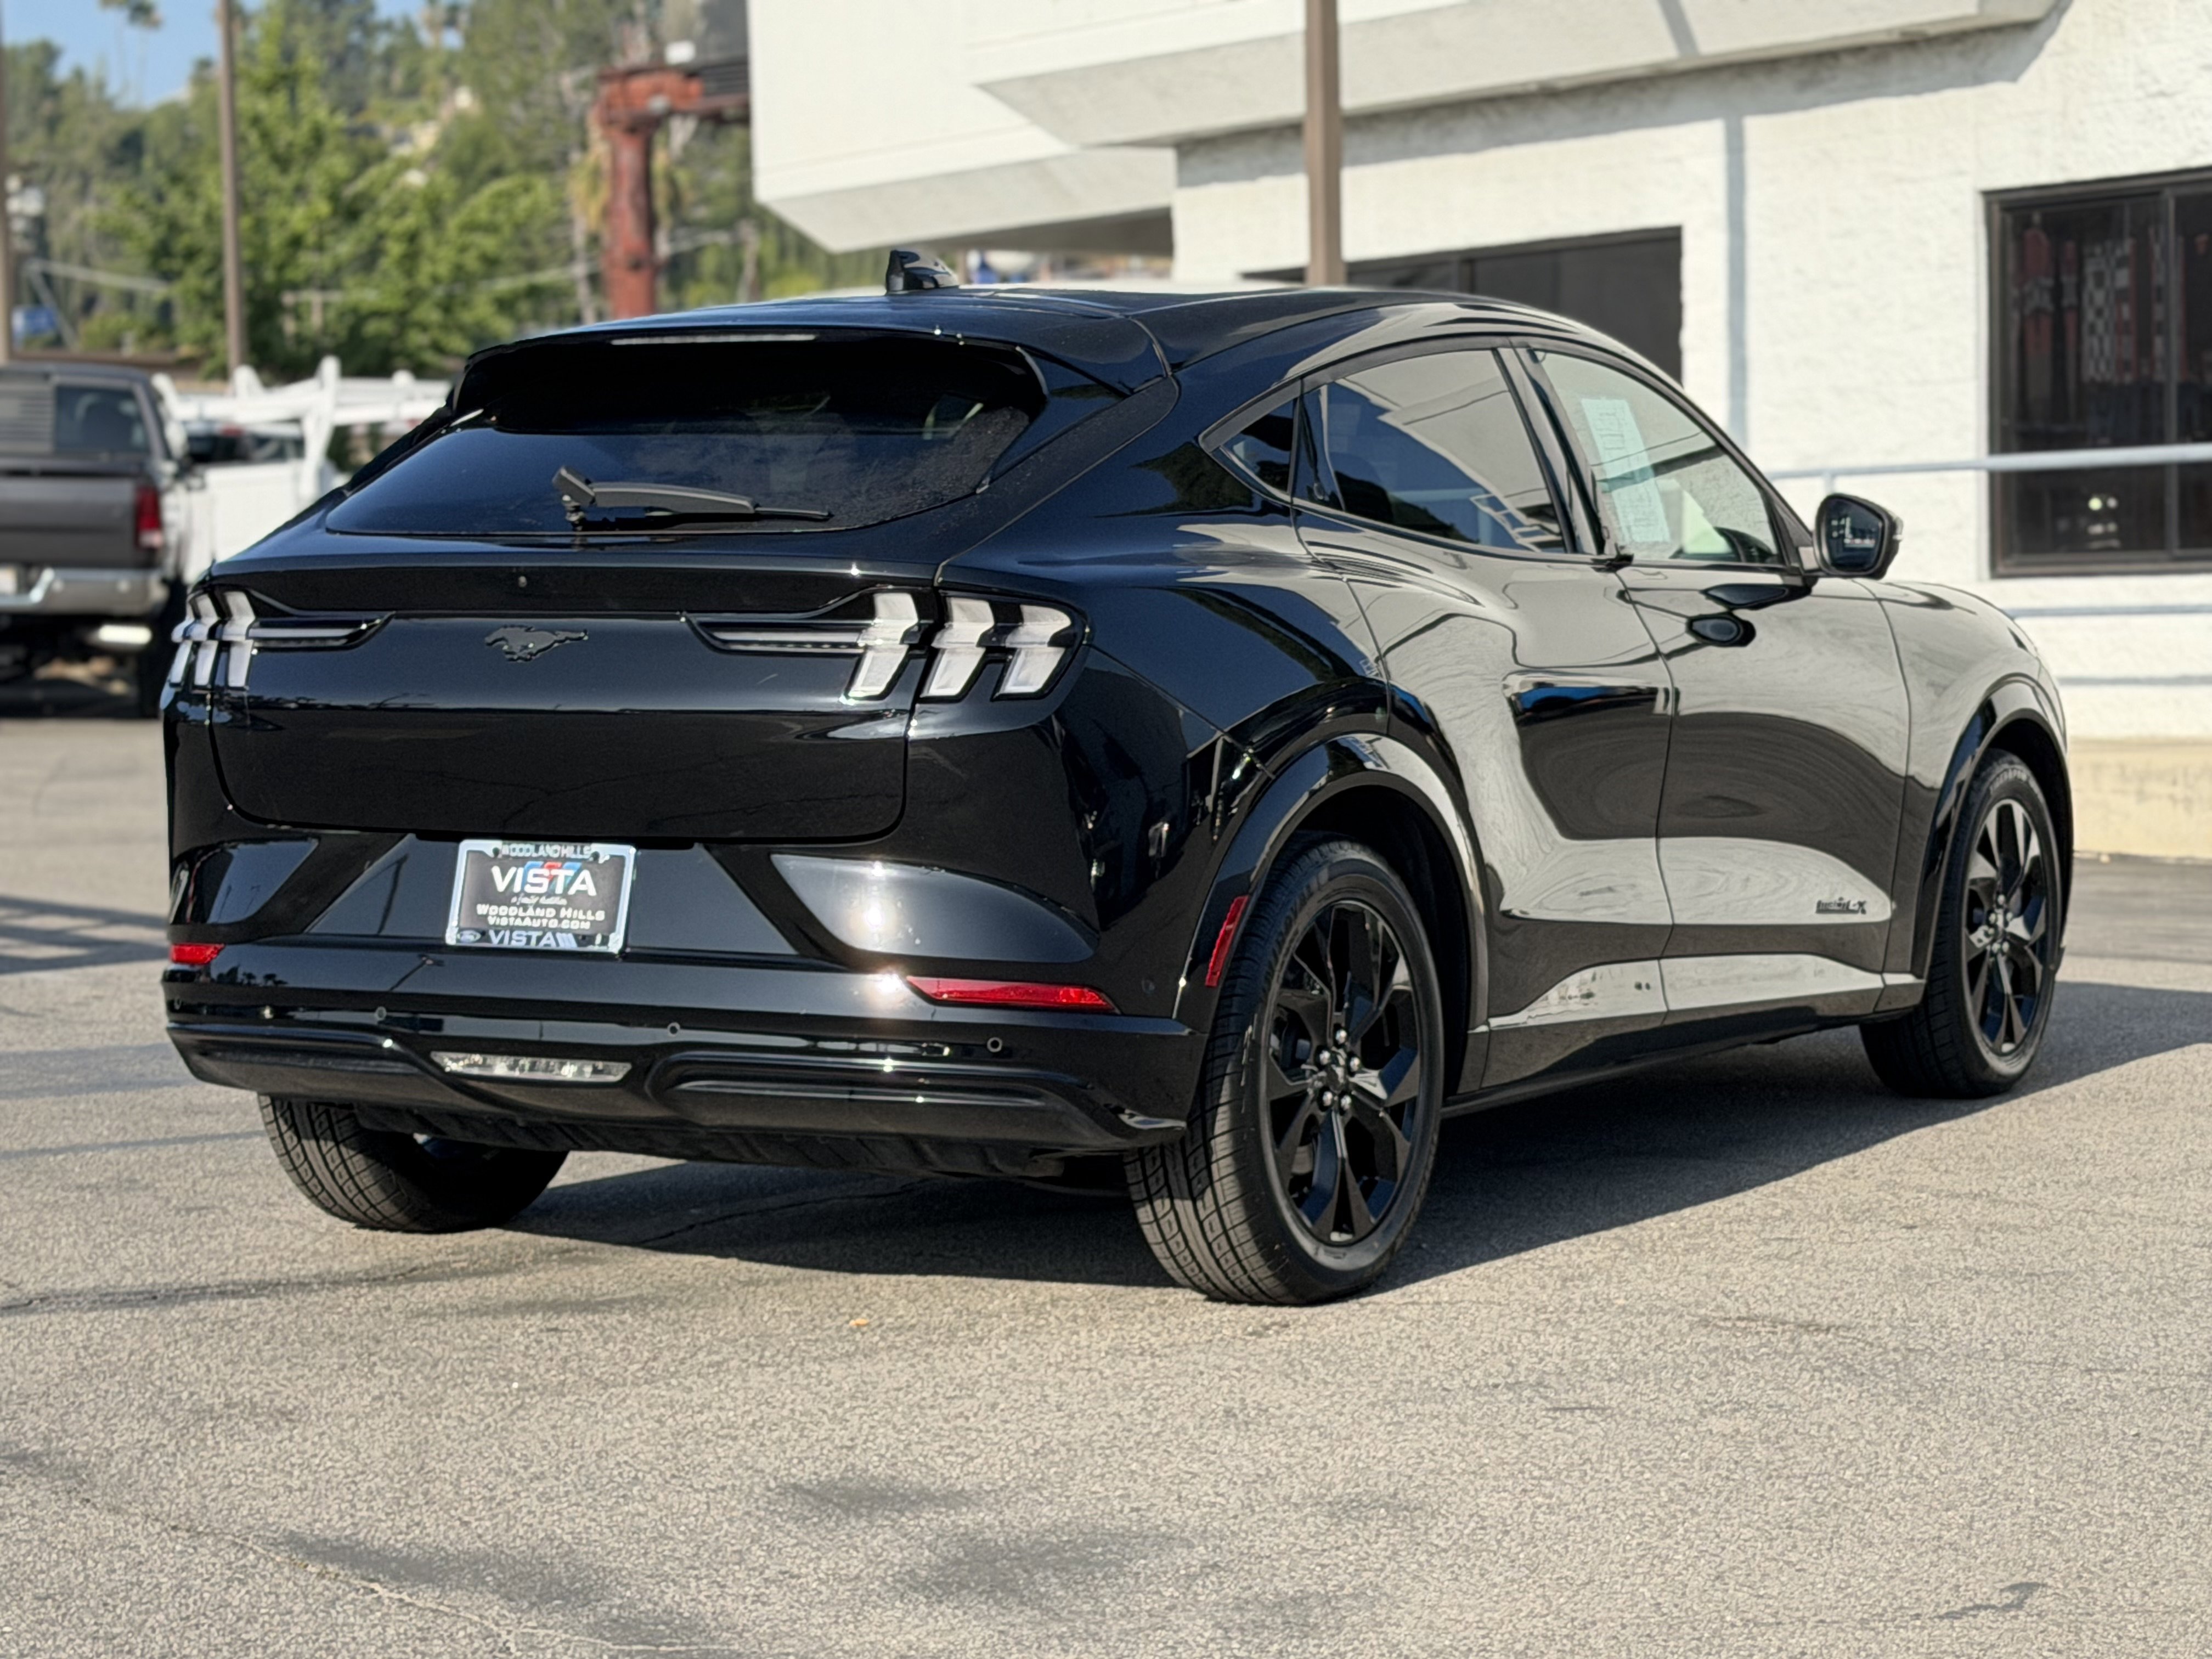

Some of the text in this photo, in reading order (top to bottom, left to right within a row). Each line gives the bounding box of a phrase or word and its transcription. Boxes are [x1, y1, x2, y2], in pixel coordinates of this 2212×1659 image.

[491, 865, 597, 896] VISTA
[476, 904, 605, 921] WOODLAND HILLS
[488, 929, 558, 947] VISTA
